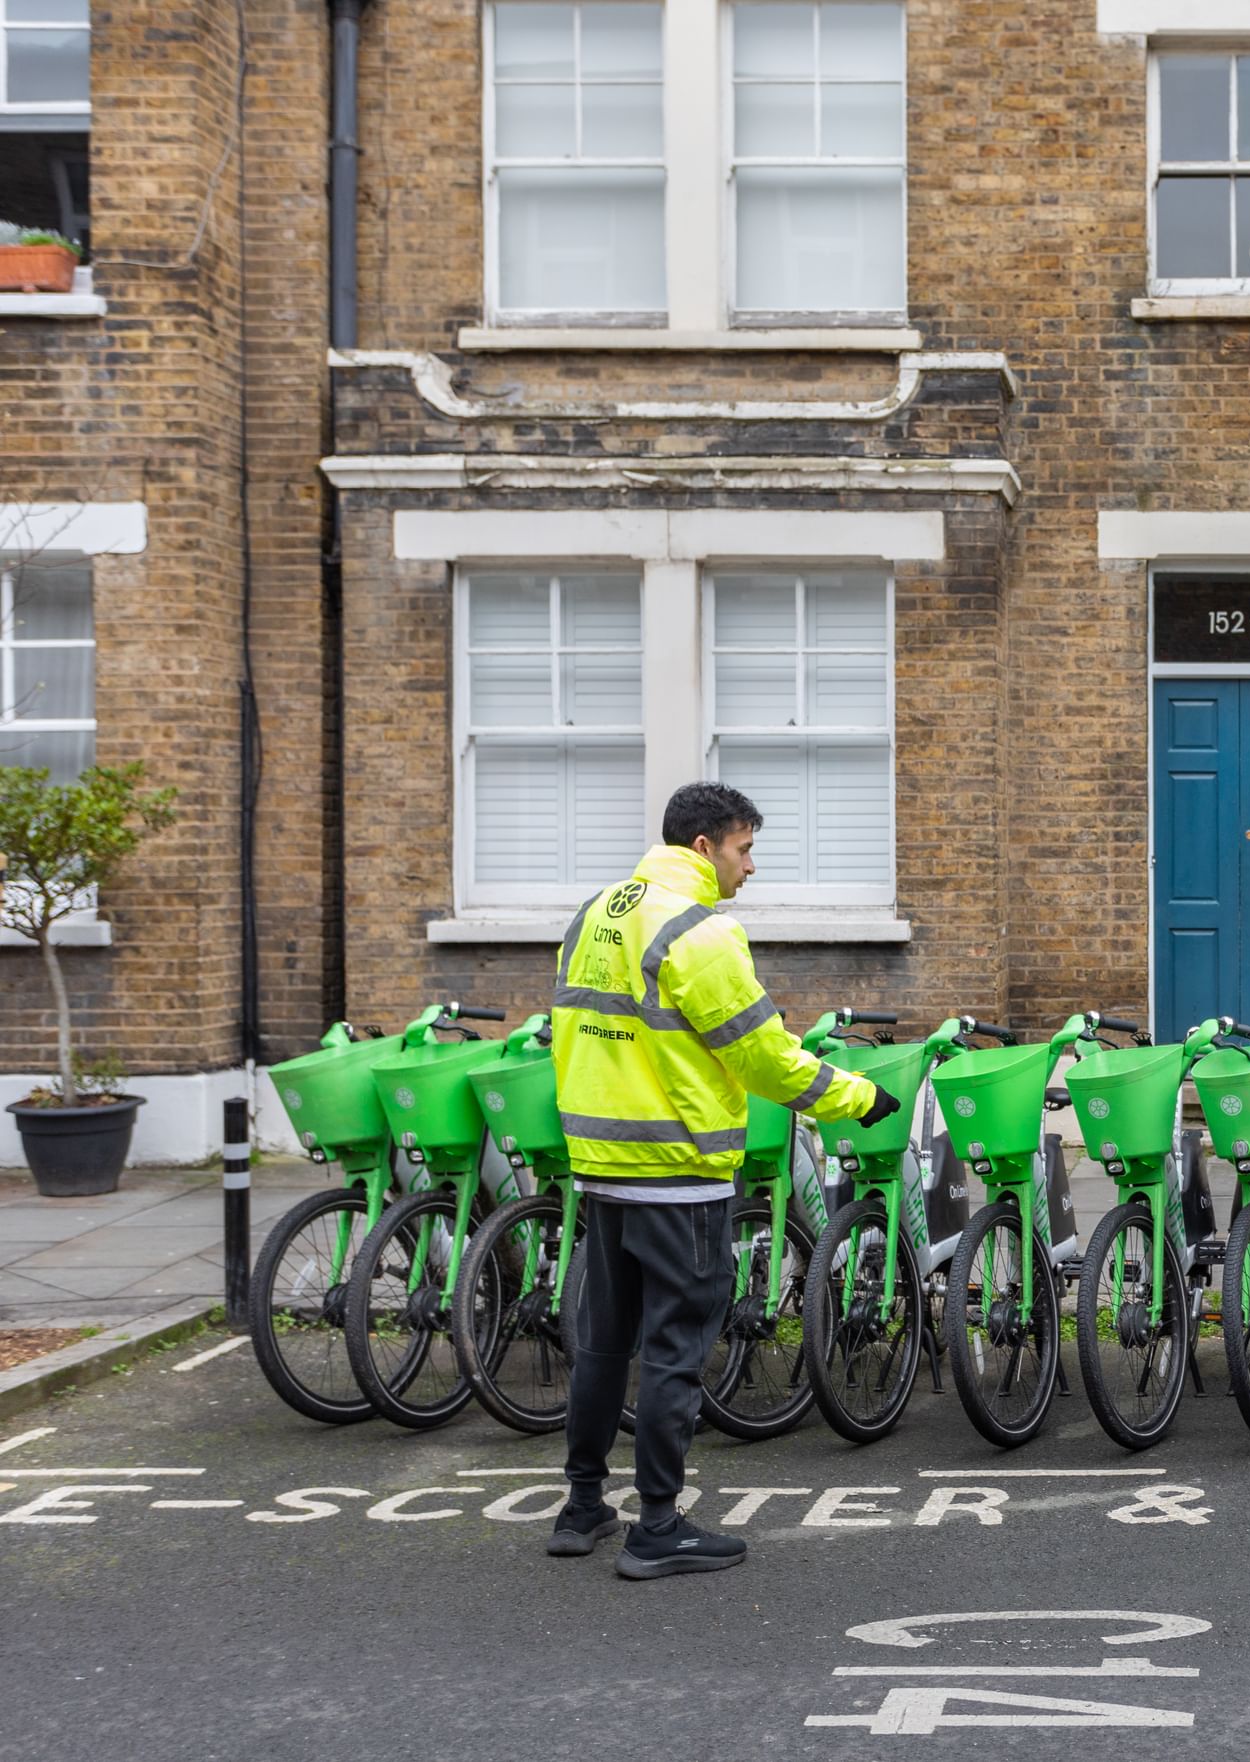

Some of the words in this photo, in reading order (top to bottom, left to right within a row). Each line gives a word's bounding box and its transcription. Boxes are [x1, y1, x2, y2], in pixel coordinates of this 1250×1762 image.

[593, 924, 623, 946] Lime
[906, 1175, 928, 1249] Lime
[0, 1484, 1009, 1526] E-SCOOTER
[1107, 1484, 1214, 1525] &
